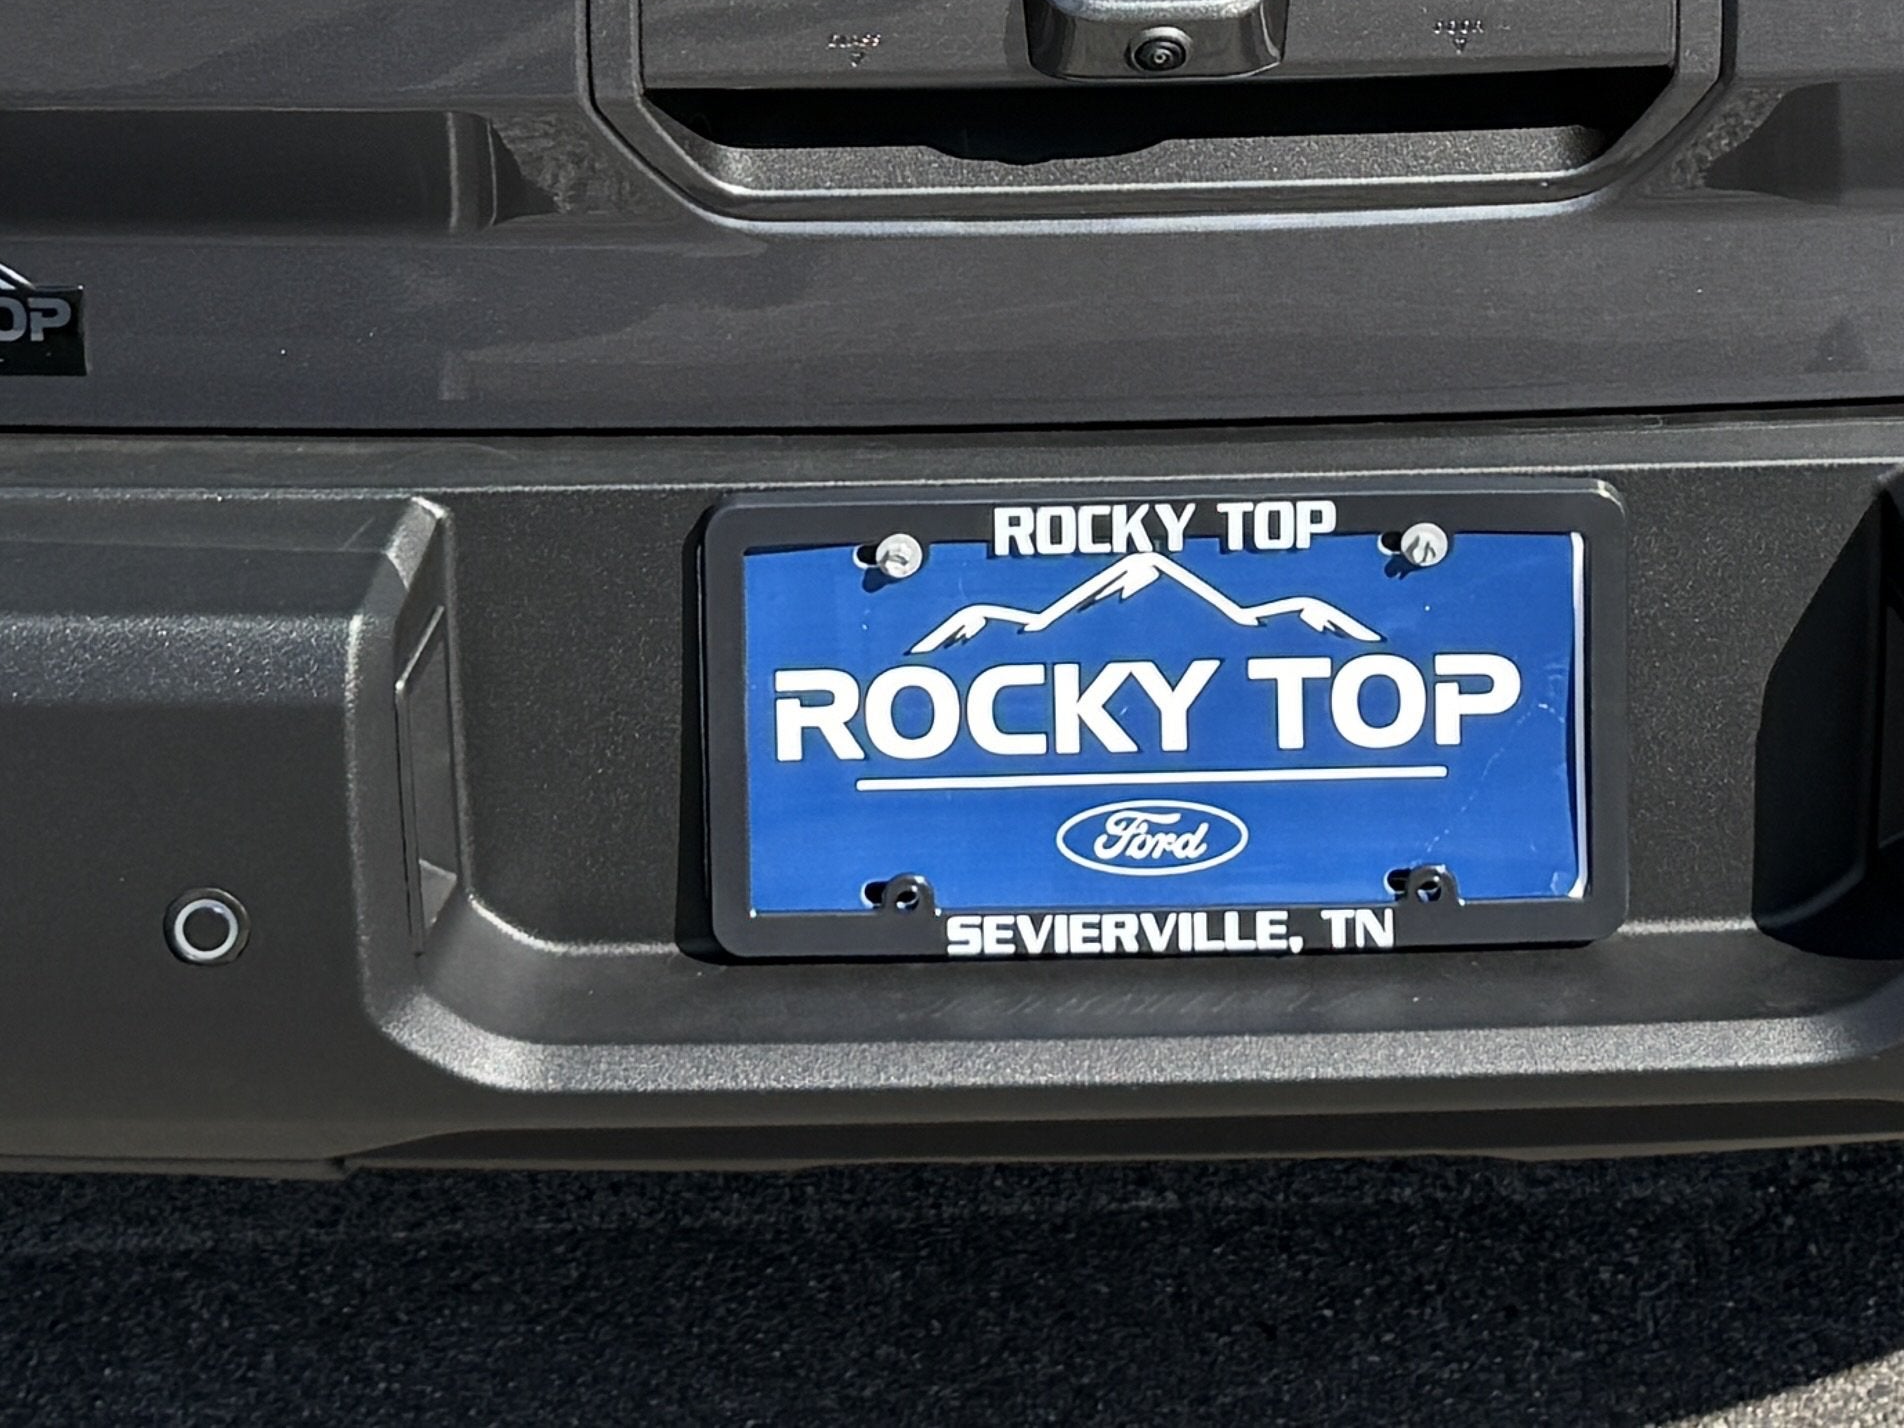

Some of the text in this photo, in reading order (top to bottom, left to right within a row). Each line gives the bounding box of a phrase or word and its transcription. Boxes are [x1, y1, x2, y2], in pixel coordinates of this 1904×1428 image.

[994, 499, 1338, 557] ROCKY TOP
[775, 653, 1522, 762] ROCKY TOP
[1093, 810, 1209, 860] Ford
[946, 907, 1395, 955] SEVIERVILLE, TN
